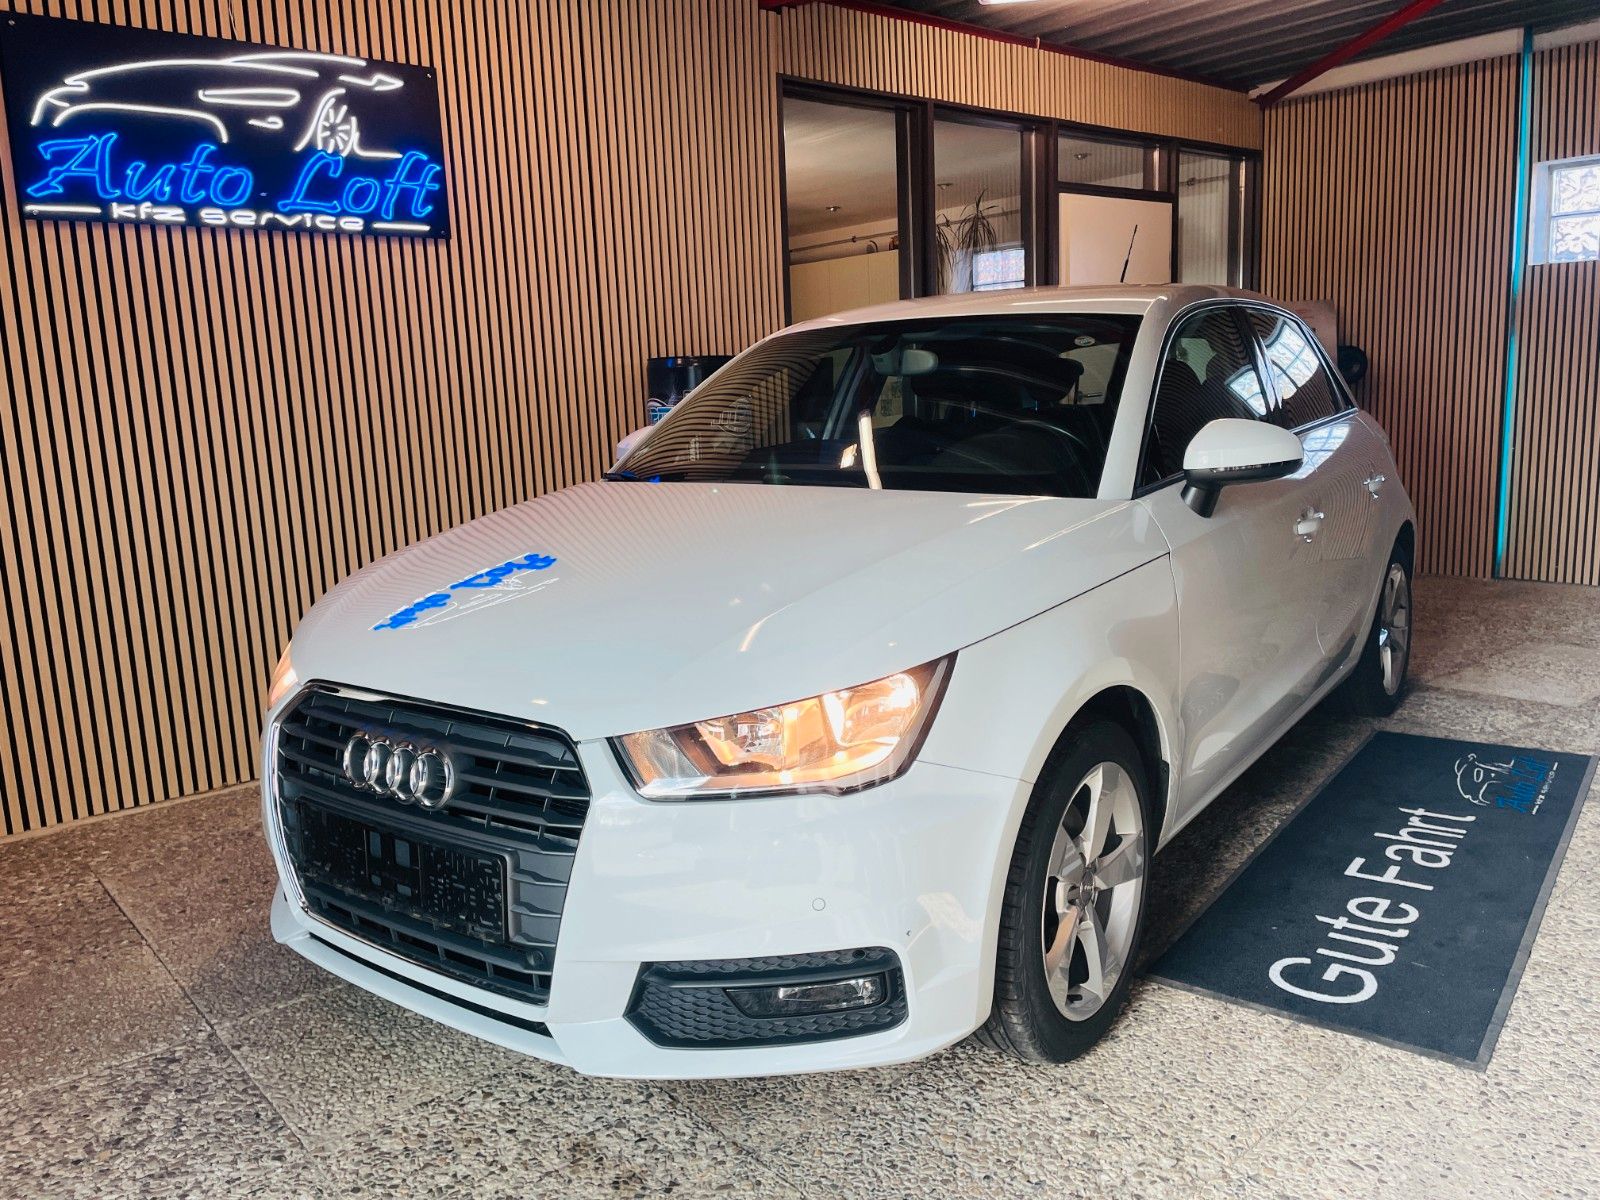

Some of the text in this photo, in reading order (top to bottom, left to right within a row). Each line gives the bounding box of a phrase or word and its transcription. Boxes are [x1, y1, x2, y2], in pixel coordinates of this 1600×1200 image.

[26, 131, 441, 220] Auto Loft
[202, 207, 365, 231] service
[1268, 806, 1477, 1004] Gute Fahrt
